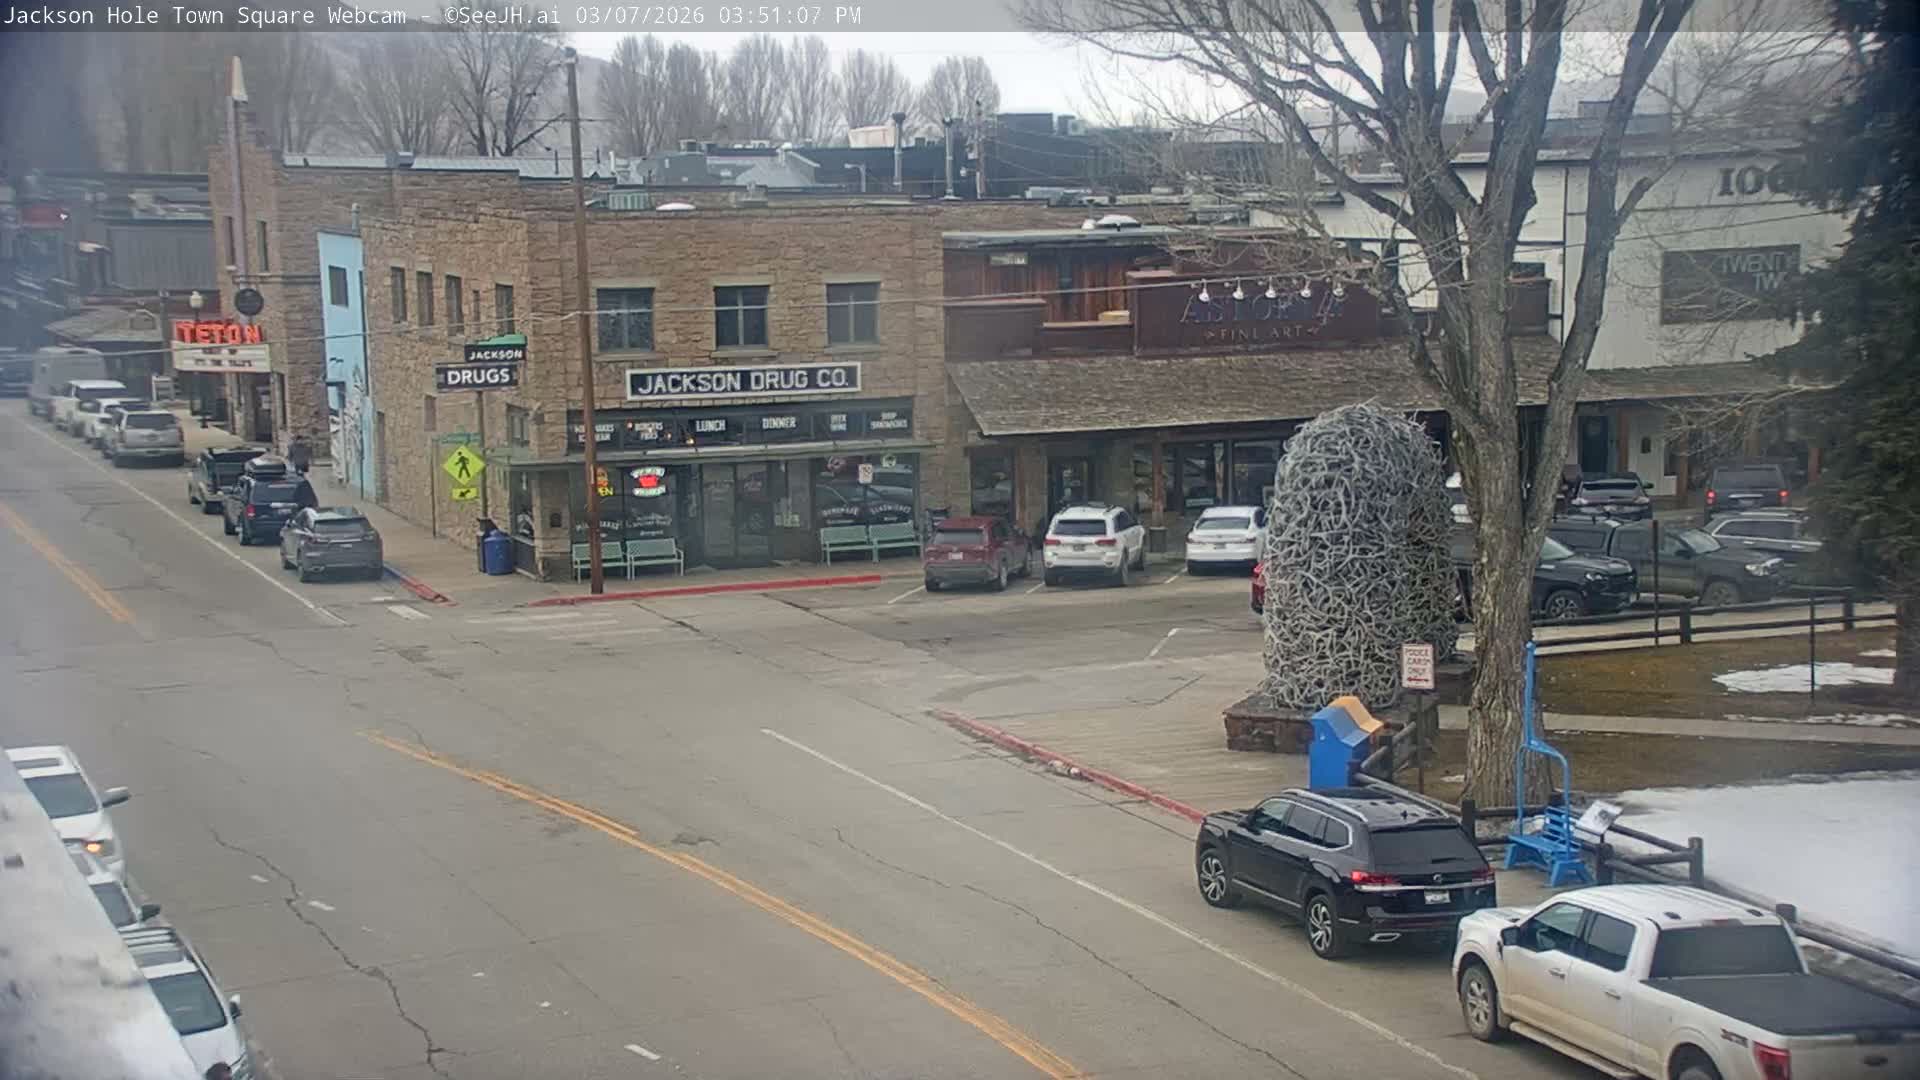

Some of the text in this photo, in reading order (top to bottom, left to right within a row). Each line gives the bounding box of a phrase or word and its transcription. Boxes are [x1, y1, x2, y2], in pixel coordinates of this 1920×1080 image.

[176, 320, 264, 345] TETON
[1272, 326, 1303, 339] ART
[469, 350, 523, 361] JACKSON
[447, 368, 510, 385] DRUGS
[638, 368, 849, 394] JACKSON DRUG CO.
[695, 420, 726, 433] LUNCH
[762, 416, 797, 430] DINNER
